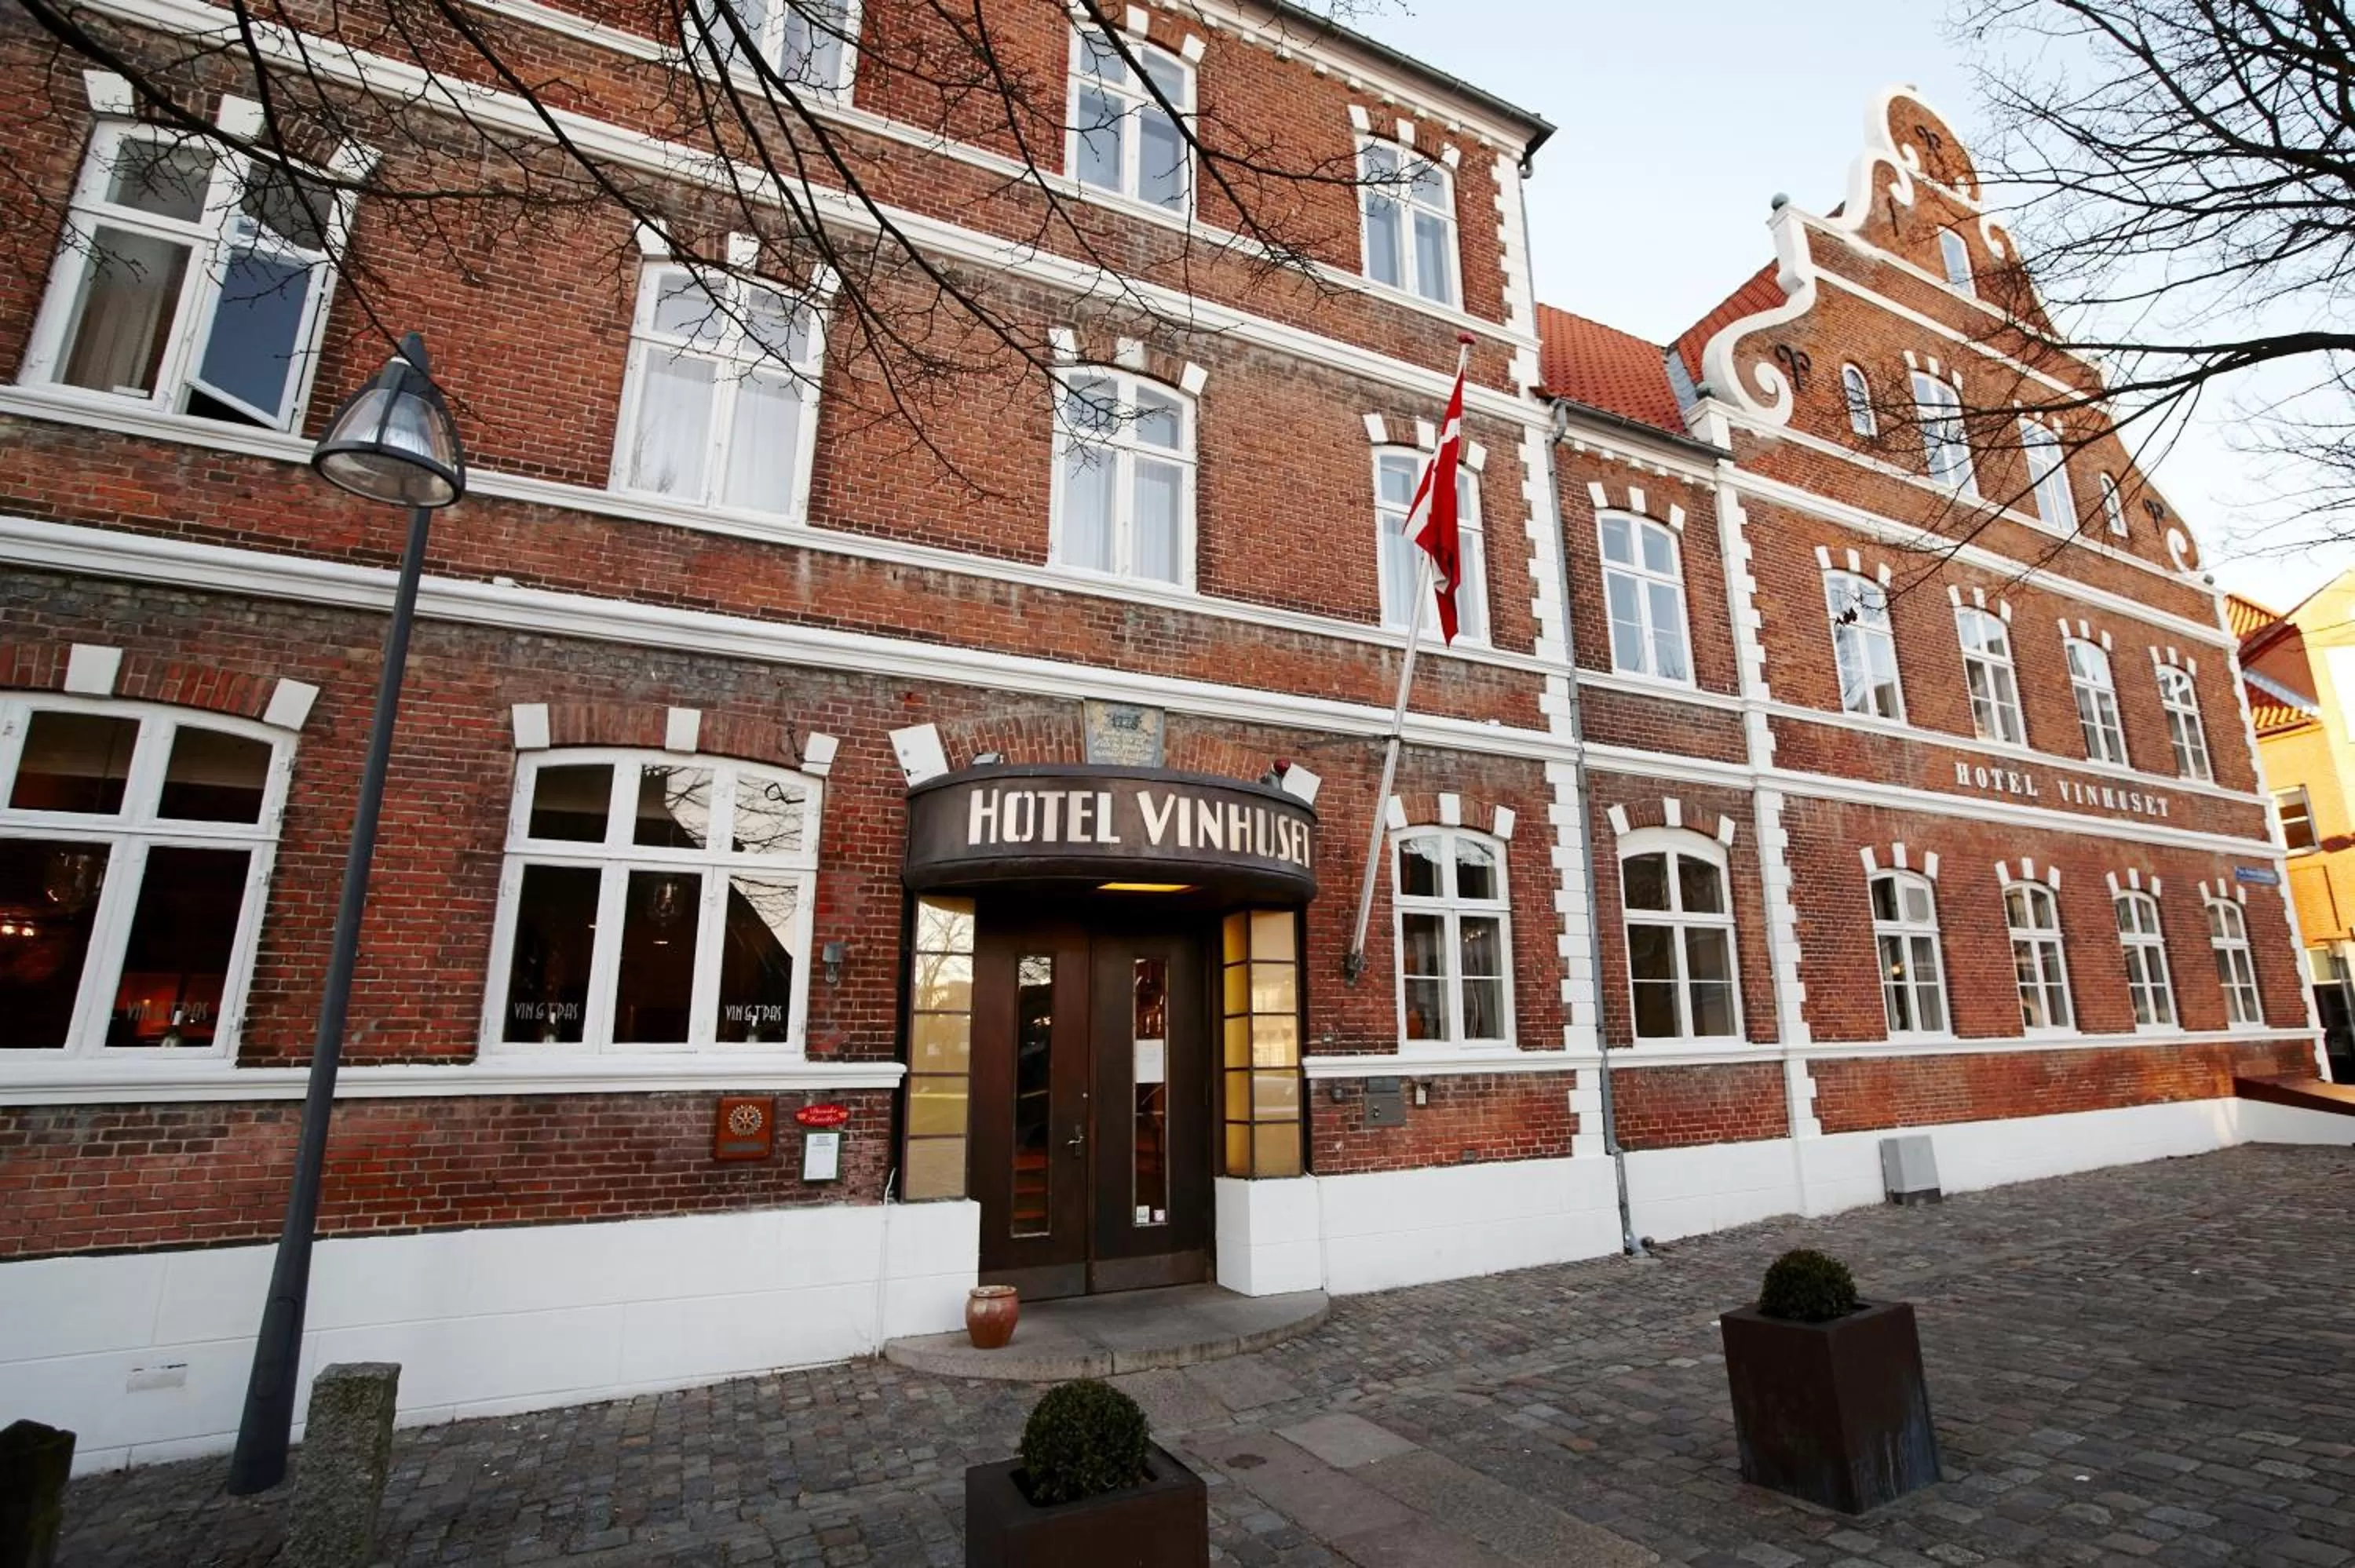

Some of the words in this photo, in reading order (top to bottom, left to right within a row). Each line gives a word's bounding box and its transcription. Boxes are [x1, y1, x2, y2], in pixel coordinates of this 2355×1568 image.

[1954, 761, 2039, 797] HOTEL
[2057, 779, 2170, 818] VINHUSET
[967, 788, 1121, 846] HOTEL
[1136, 792, 1312, 869] VINHUSET
[514, 1001, 535, 1020] VIN
[725, 1004, 743, 1021] VIN
